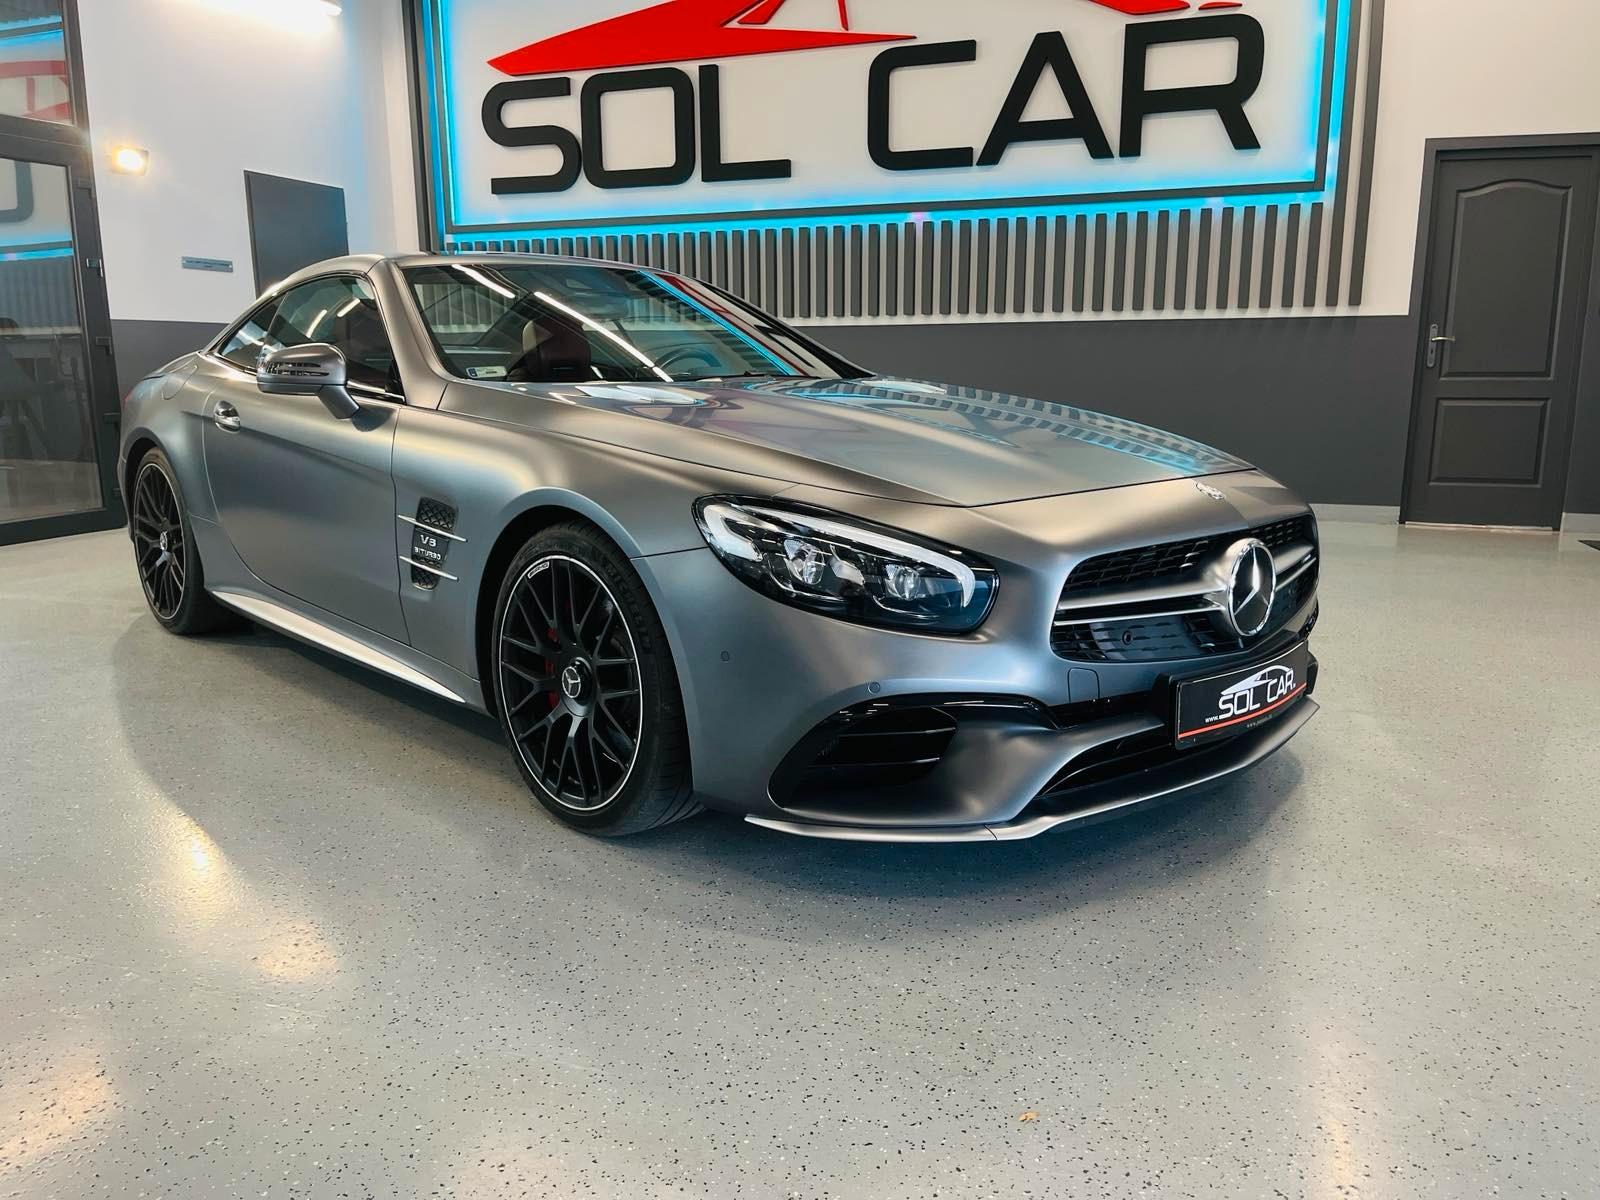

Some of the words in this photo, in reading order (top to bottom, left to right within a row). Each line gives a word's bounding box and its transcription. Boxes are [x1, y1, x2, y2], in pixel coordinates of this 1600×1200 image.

[482, 64, 791, 194] SOL
[868, 14, 1264, 170] CAR
[420, 534, 437, 547] V8
[414, 546, 441, 561] BITURBO
[1218, 687, 1261, 720] SOL
